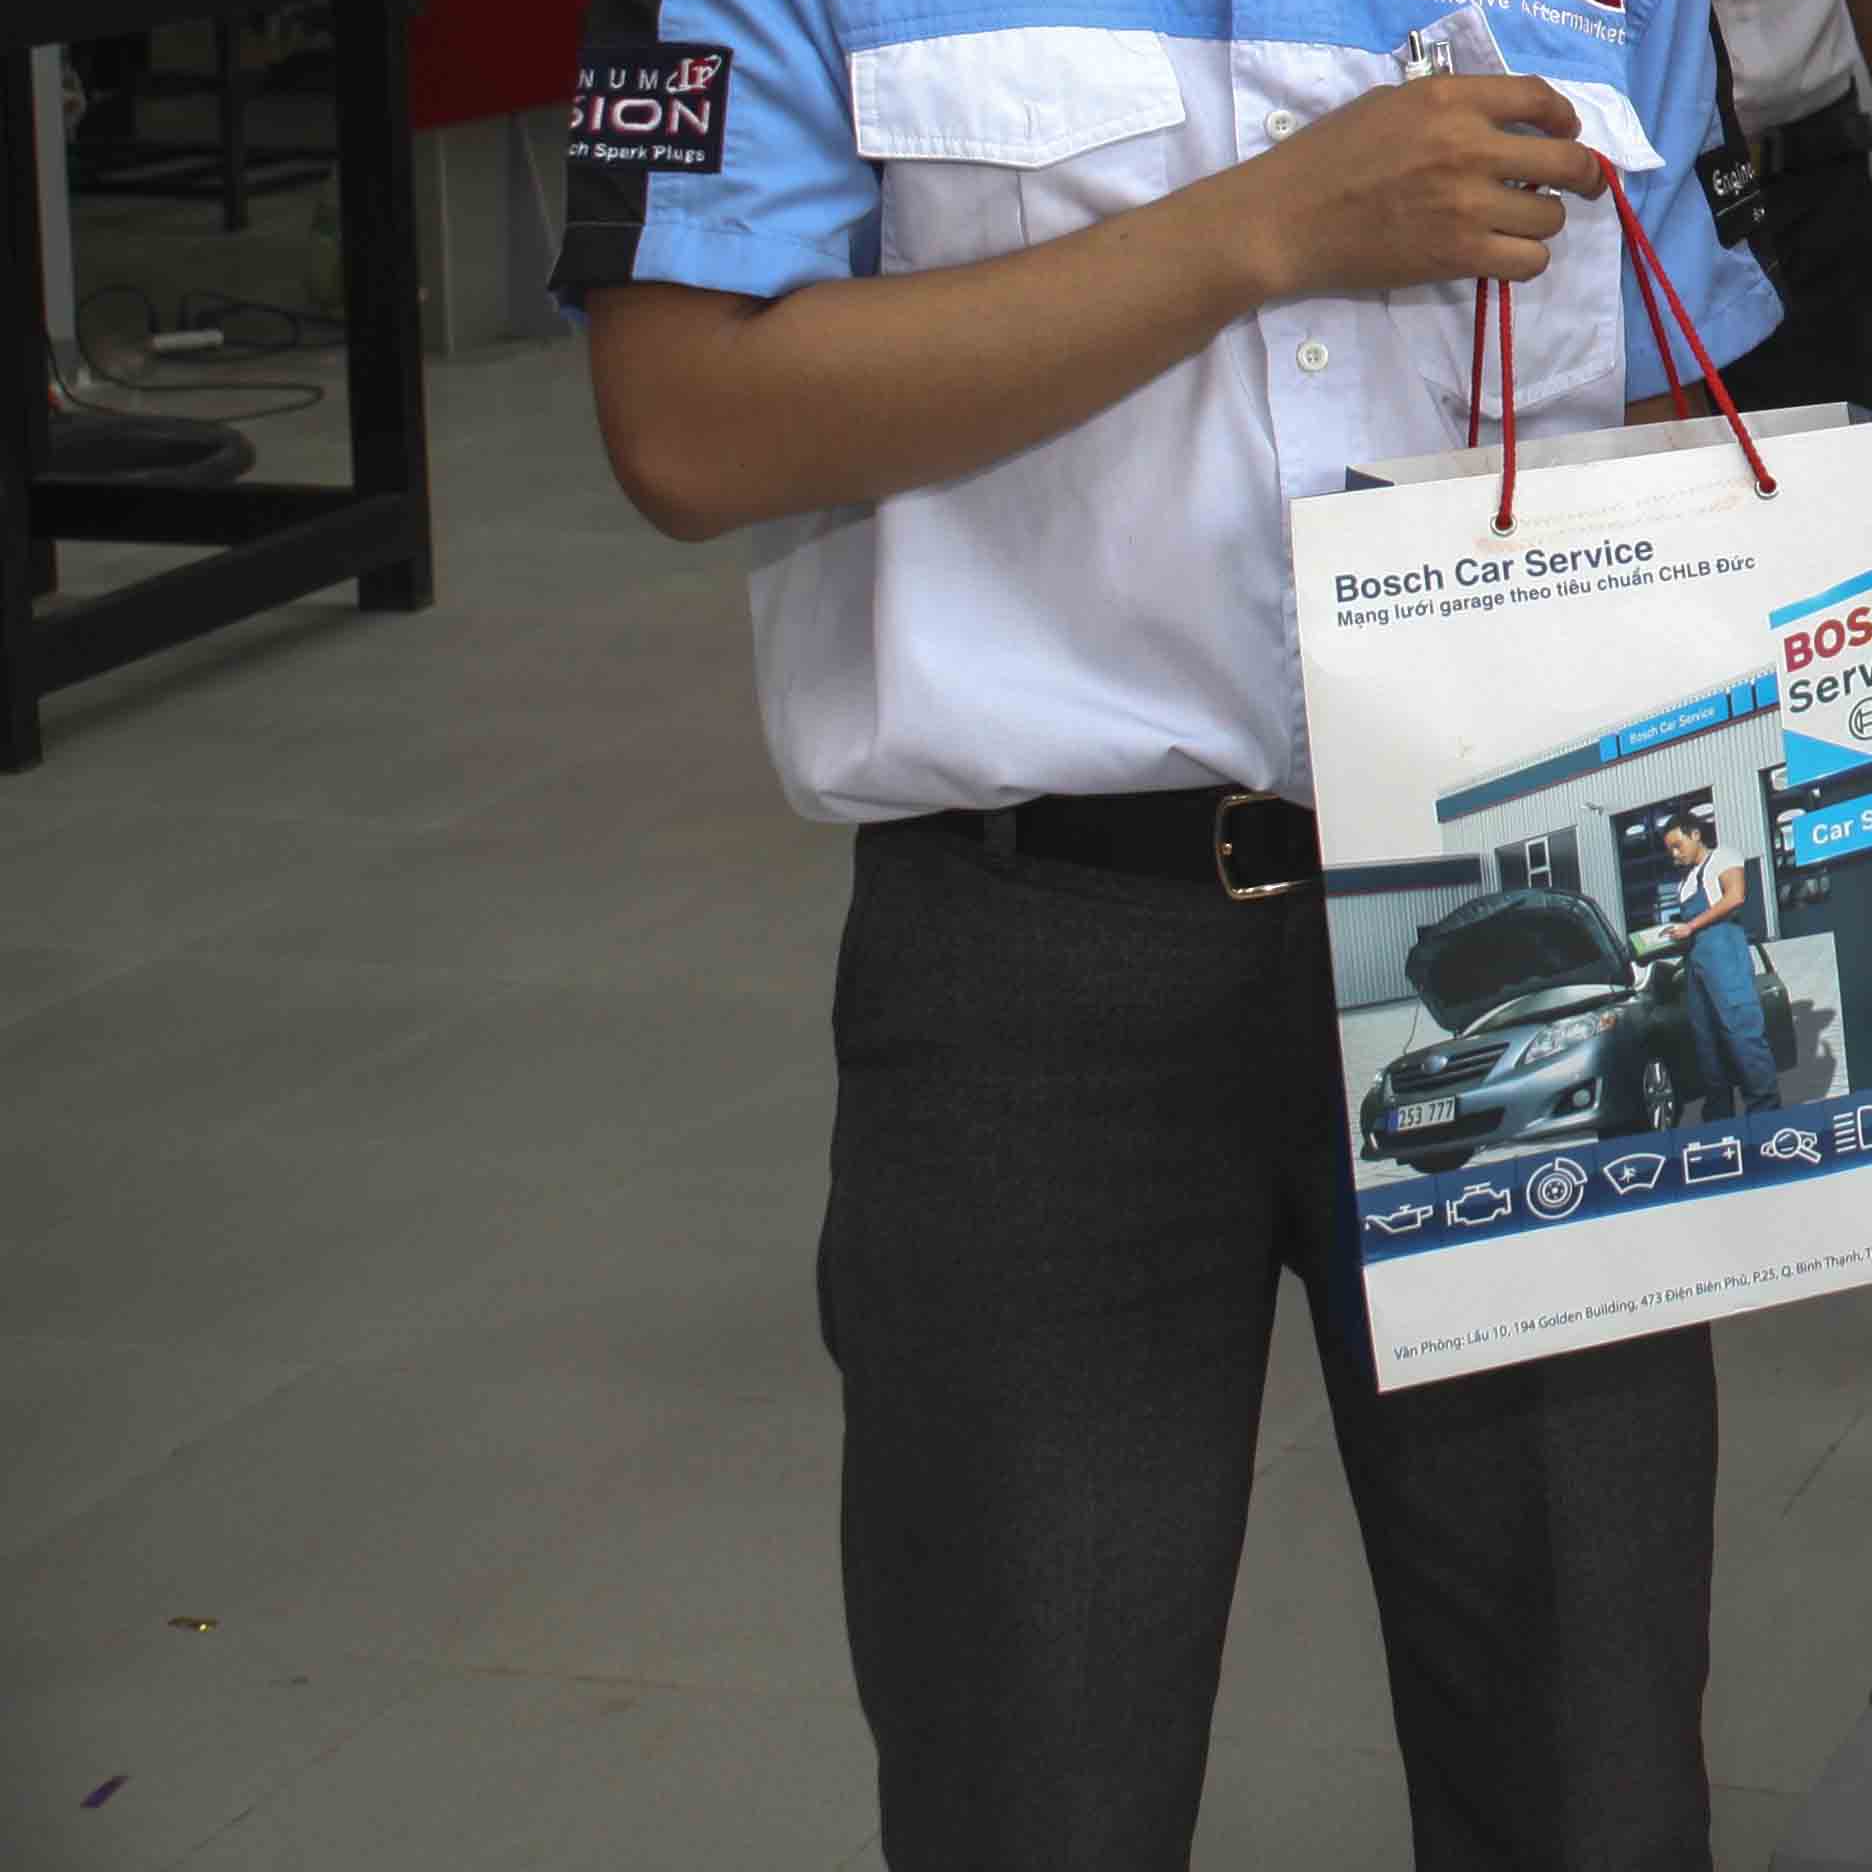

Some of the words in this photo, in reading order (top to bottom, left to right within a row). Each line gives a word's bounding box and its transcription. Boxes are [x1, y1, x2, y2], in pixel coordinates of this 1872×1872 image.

[594, 143, 648, 161] Spark
[653, 145, 705, 163] Plugs
[1336, 564, 1443, 602] Bosch
[1455, 558, 1514, 586] Car
[1525, 539, 1653, 577] Service
[1337, 608, 1389, 628] Mạng
[1395, 598, 1434, 619] lưới
[1440, 592, 1505, 617] garage
[1510, 586, 1551, 603] theo
[1557, 578, 1591, 597] tiêu
[1659, 561, 1711, 582] CHLB
[1716, 554, 1756, 574] Đức
[1812, 820, 1854, 845] Car
[1538, 1309, 1582, 1328] Golden
[1585, 1298, 1638, 1320] Building,
[1641, 1291, 1662, 1308] 473
